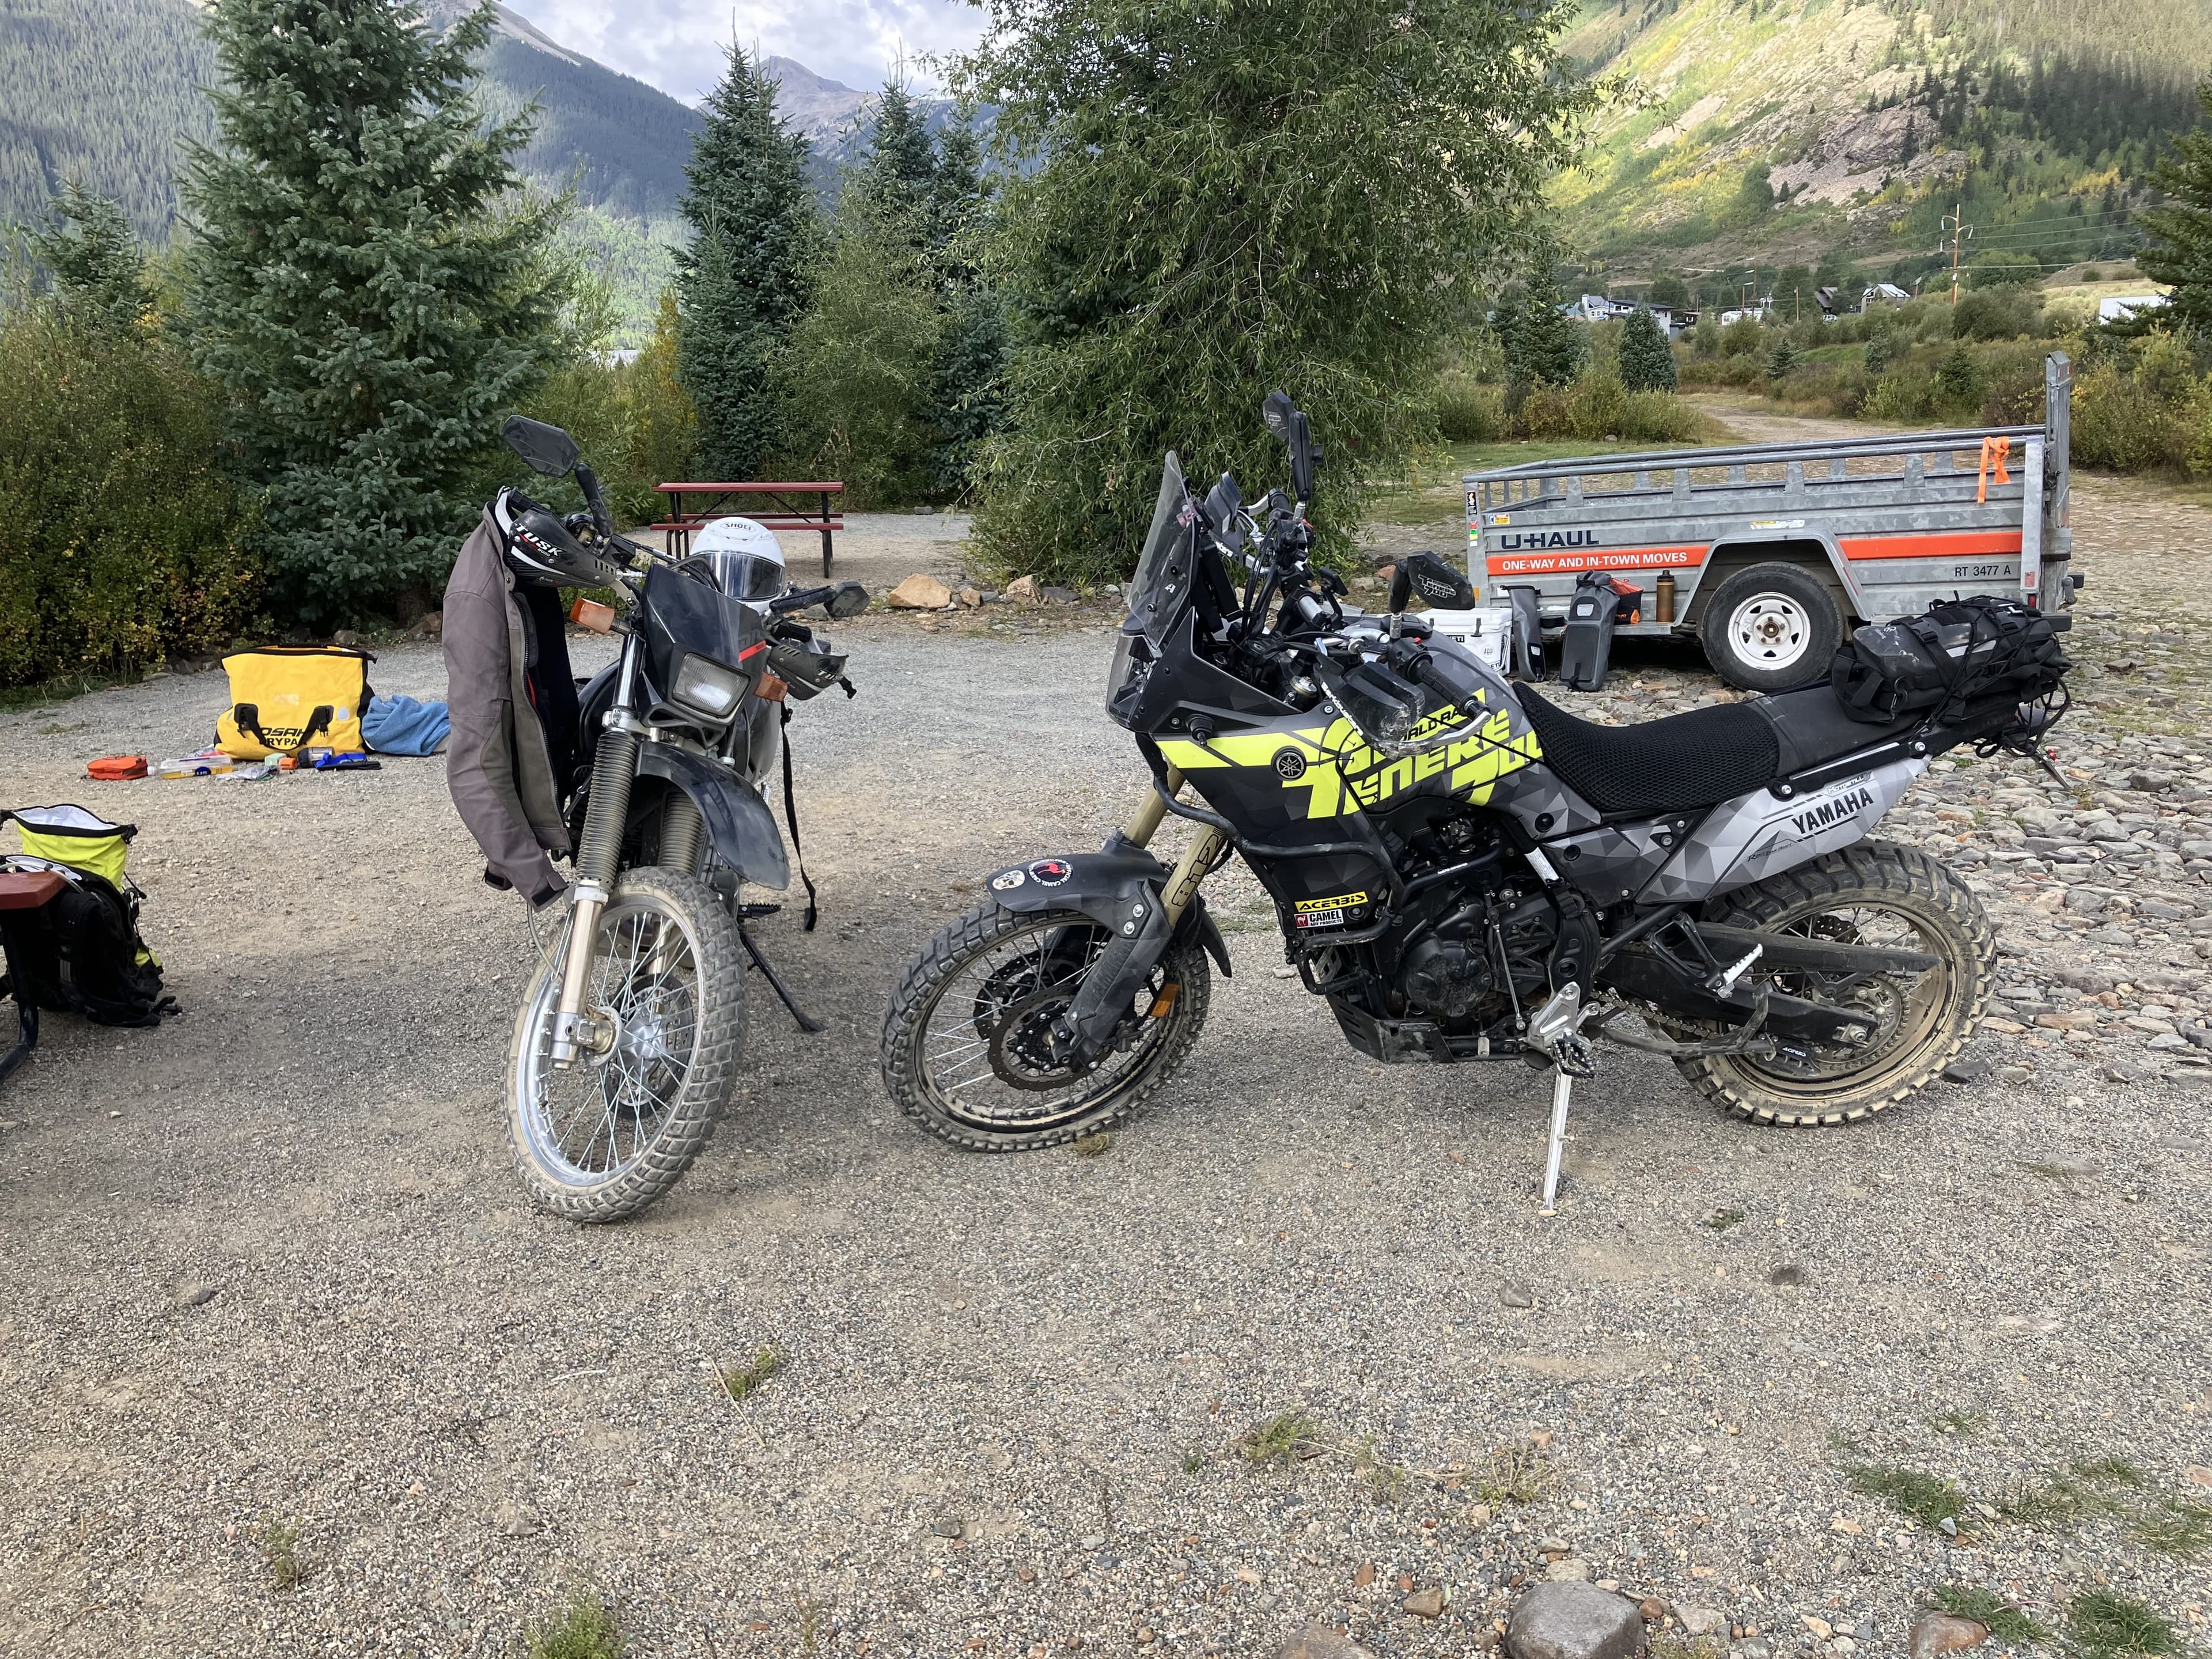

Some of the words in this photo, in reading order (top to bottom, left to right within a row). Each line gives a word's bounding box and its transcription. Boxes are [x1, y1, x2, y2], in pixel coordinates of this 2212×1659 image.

[516, 523, 563, 556] TUSK
[1501, 529, 1600, 550] U-HAUL
[1502, 559, 1555, 570] ONE-WAY
[1558, 557, 1584, 568] AND
[1586, 554, 1640, 566] IN-TOWN
[1642, 552, 1687, 564] MOVES
[1955, 566, 1968, 577] RT
[1973, 565, 1999, 576] 3477
[2003, 565, 2011, 575] A
[1791, 787, 1874, 834] YAMAHA
[1309, 910, 1341, 923] CAMEL
